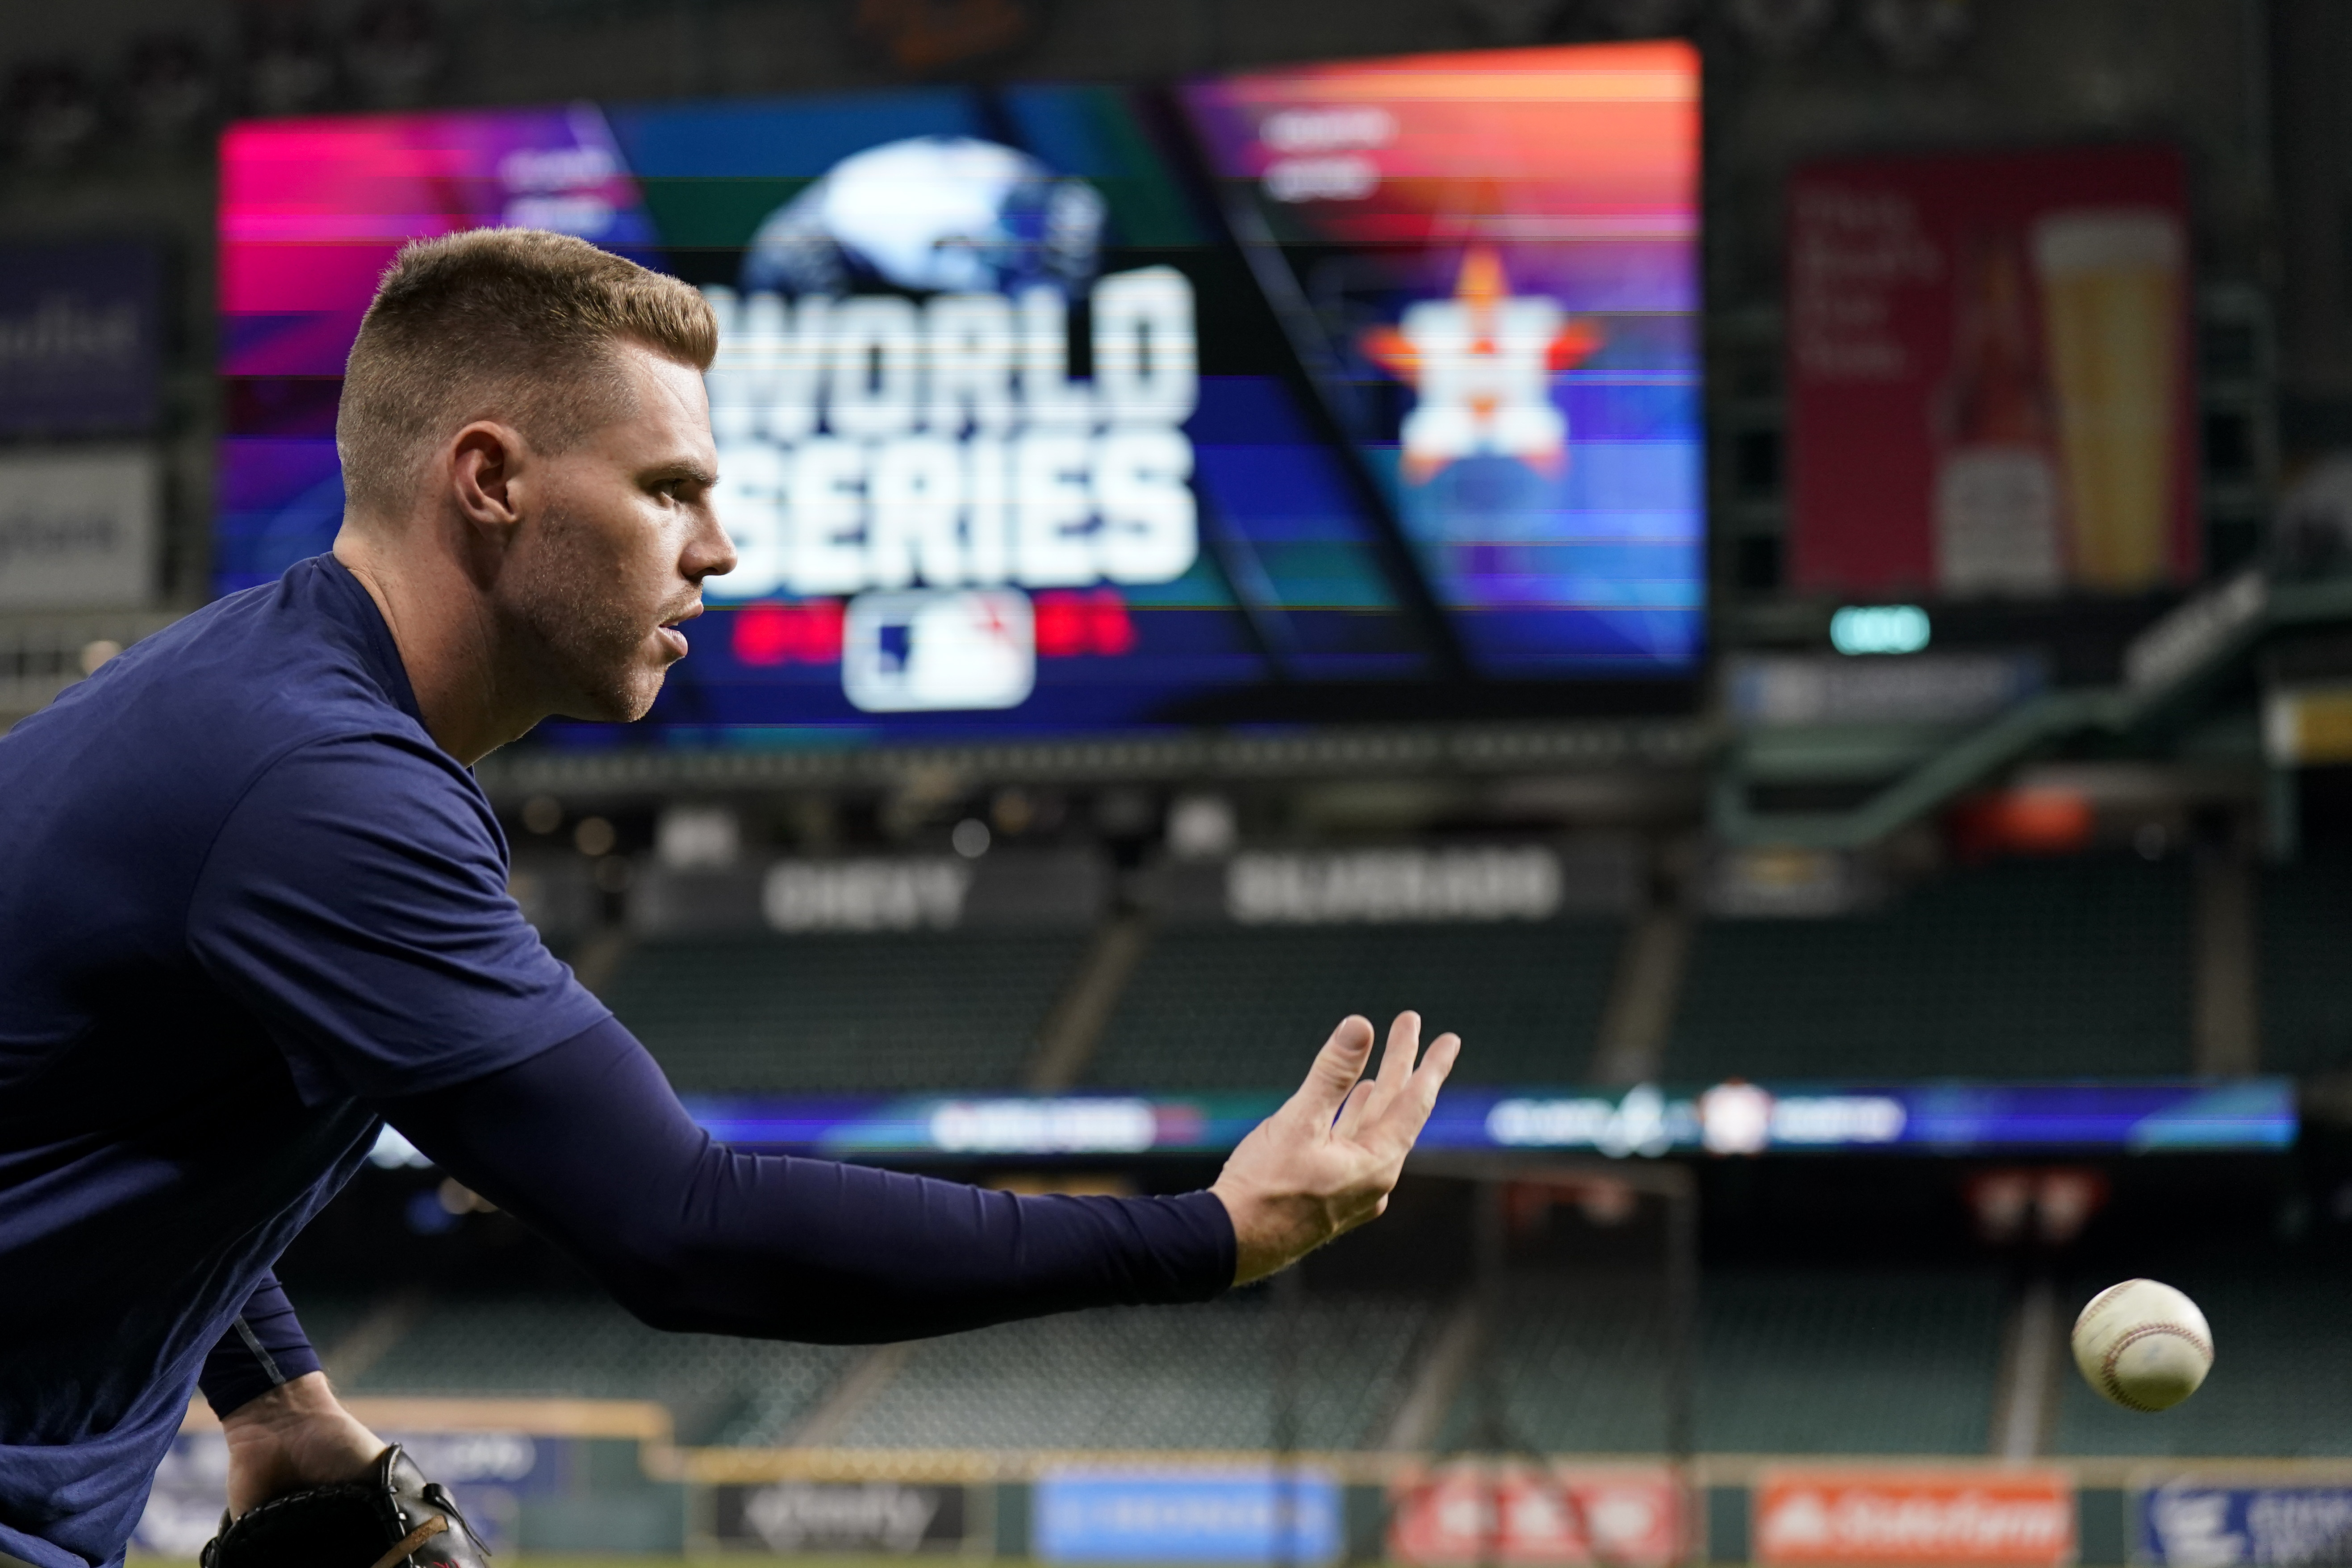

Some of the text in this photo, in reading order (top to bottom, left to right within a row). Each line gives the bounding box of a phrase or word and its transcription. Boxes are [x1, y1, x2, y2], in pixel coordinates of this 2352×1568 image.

[700, 264, 1199, 437] WORLD
[700, 424, 1198, 598] SERIES
[1227, 845, 1564, 926] SILVERADO
